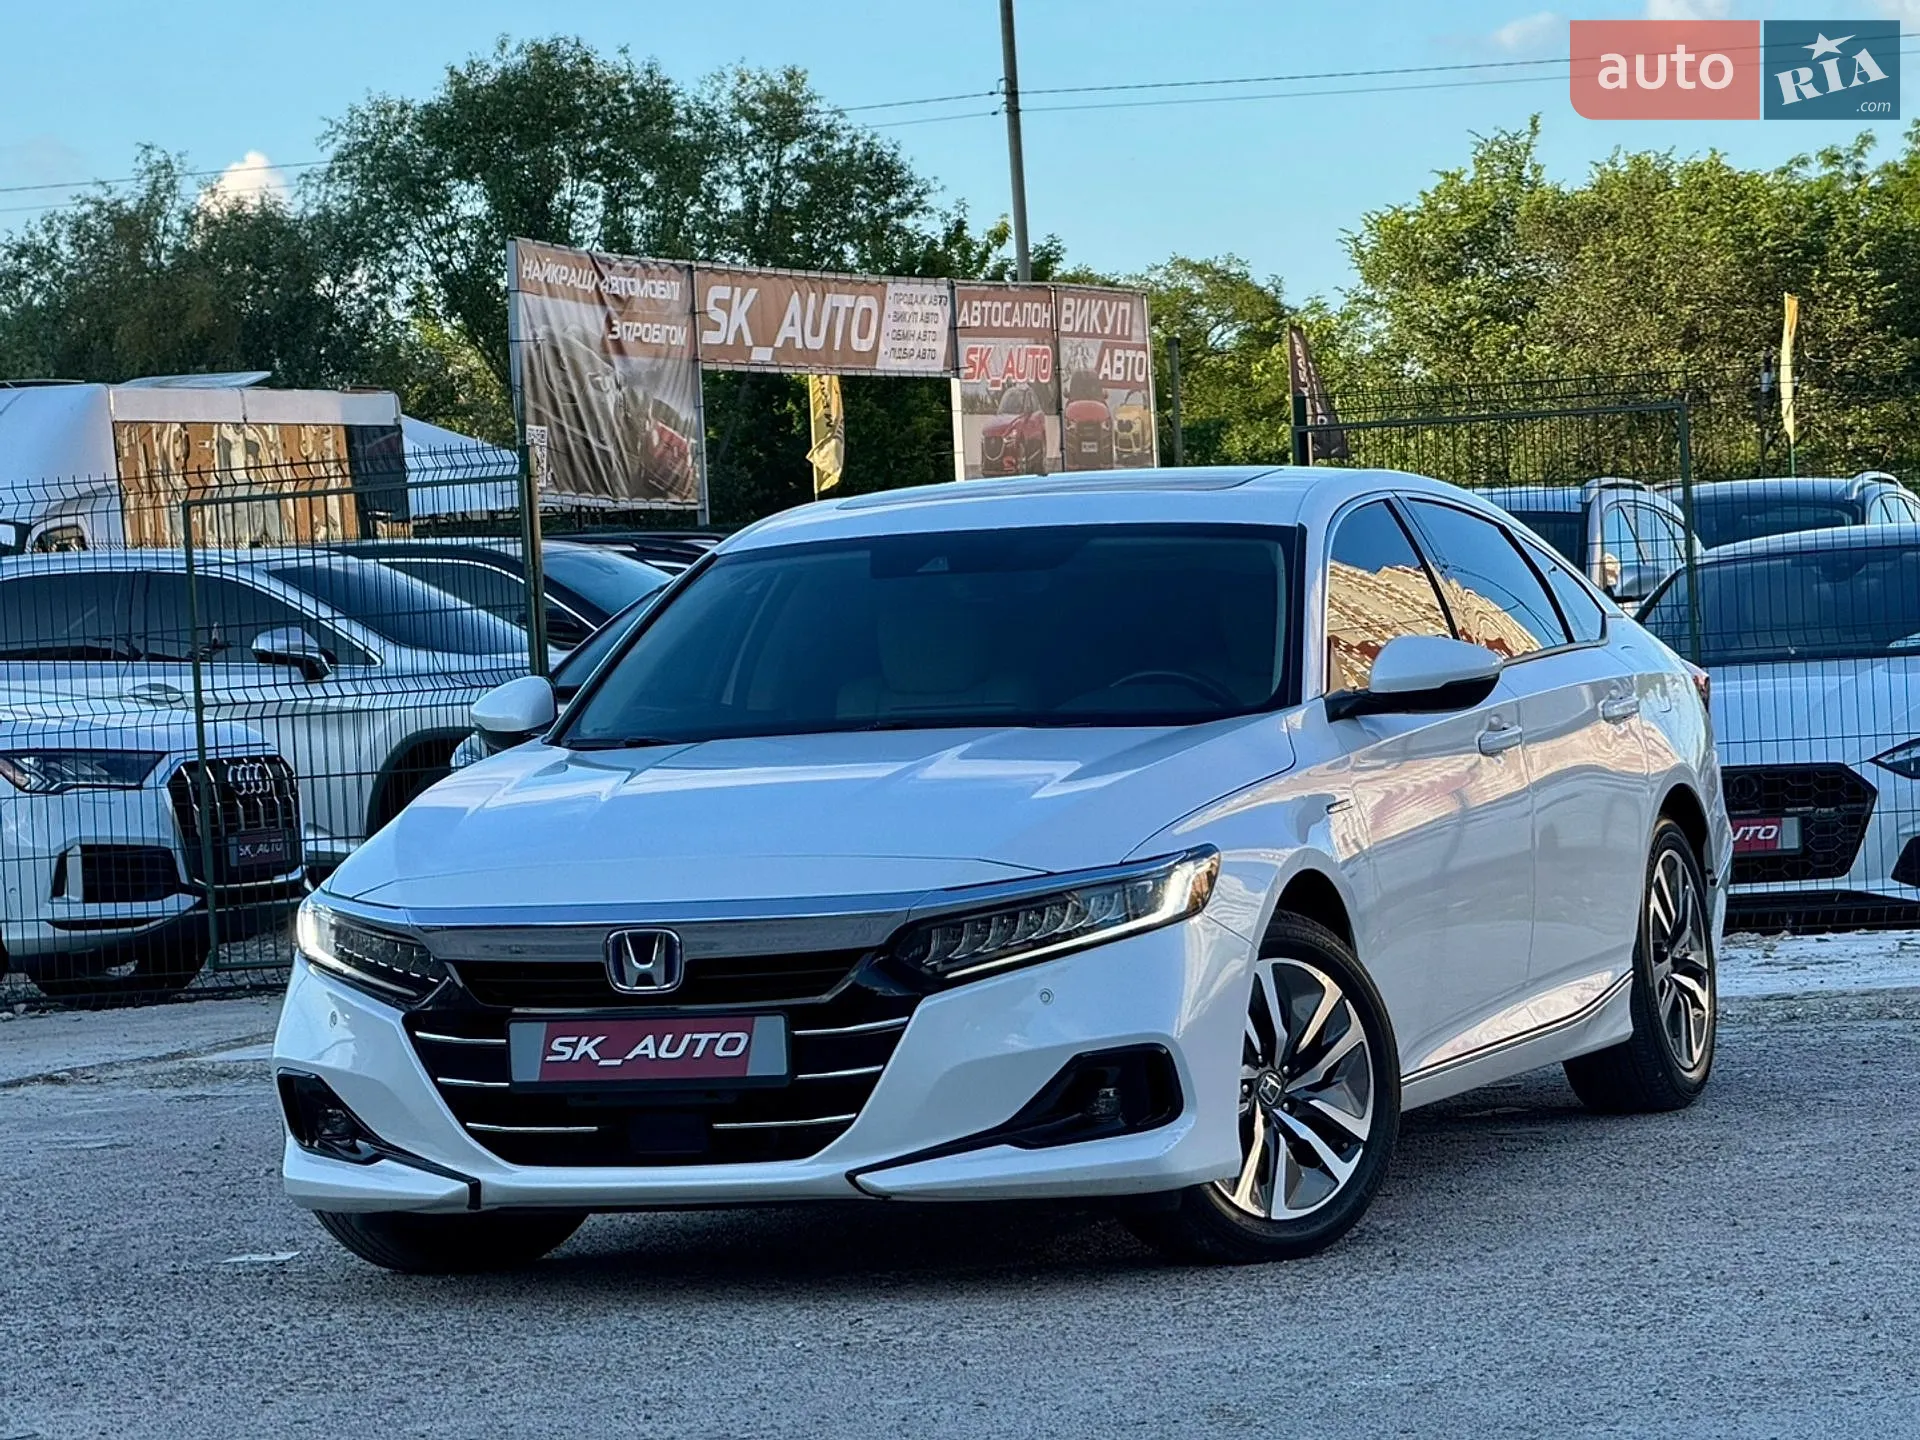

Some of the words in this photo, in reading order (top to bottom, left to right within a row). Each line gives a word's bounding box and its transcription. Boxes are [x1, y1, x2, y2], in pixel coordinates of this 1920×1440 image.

[522, 258, 597, 292] НАЙКРАЩІ
[600, 274, 680, 301] АВТОМОБІЛІ
[894, 292, 928, 305] ПРОДАЖ
[928, 294, 948, 306] АВТО
[958, 300, 1053, 328] АВТОСАЛОН
[701, 285, 879, 361] SK_AUTO
[892, 310, 918, 323] ВИКУП
[919, 312, 939, 324] АВТО
[1059, 297, 1131, 336] ВИКУП
[891, 329, 916, 341] ОБМІН
[916, 330, 937, 342] АВТО
[915, 348, 937, 361] АВТО
[963, 344, 1053, 390] SK_AUTO
[1099, 348, 1147, 382] АВТО
[545, 1031, 750, 1066] SK_AUTO
